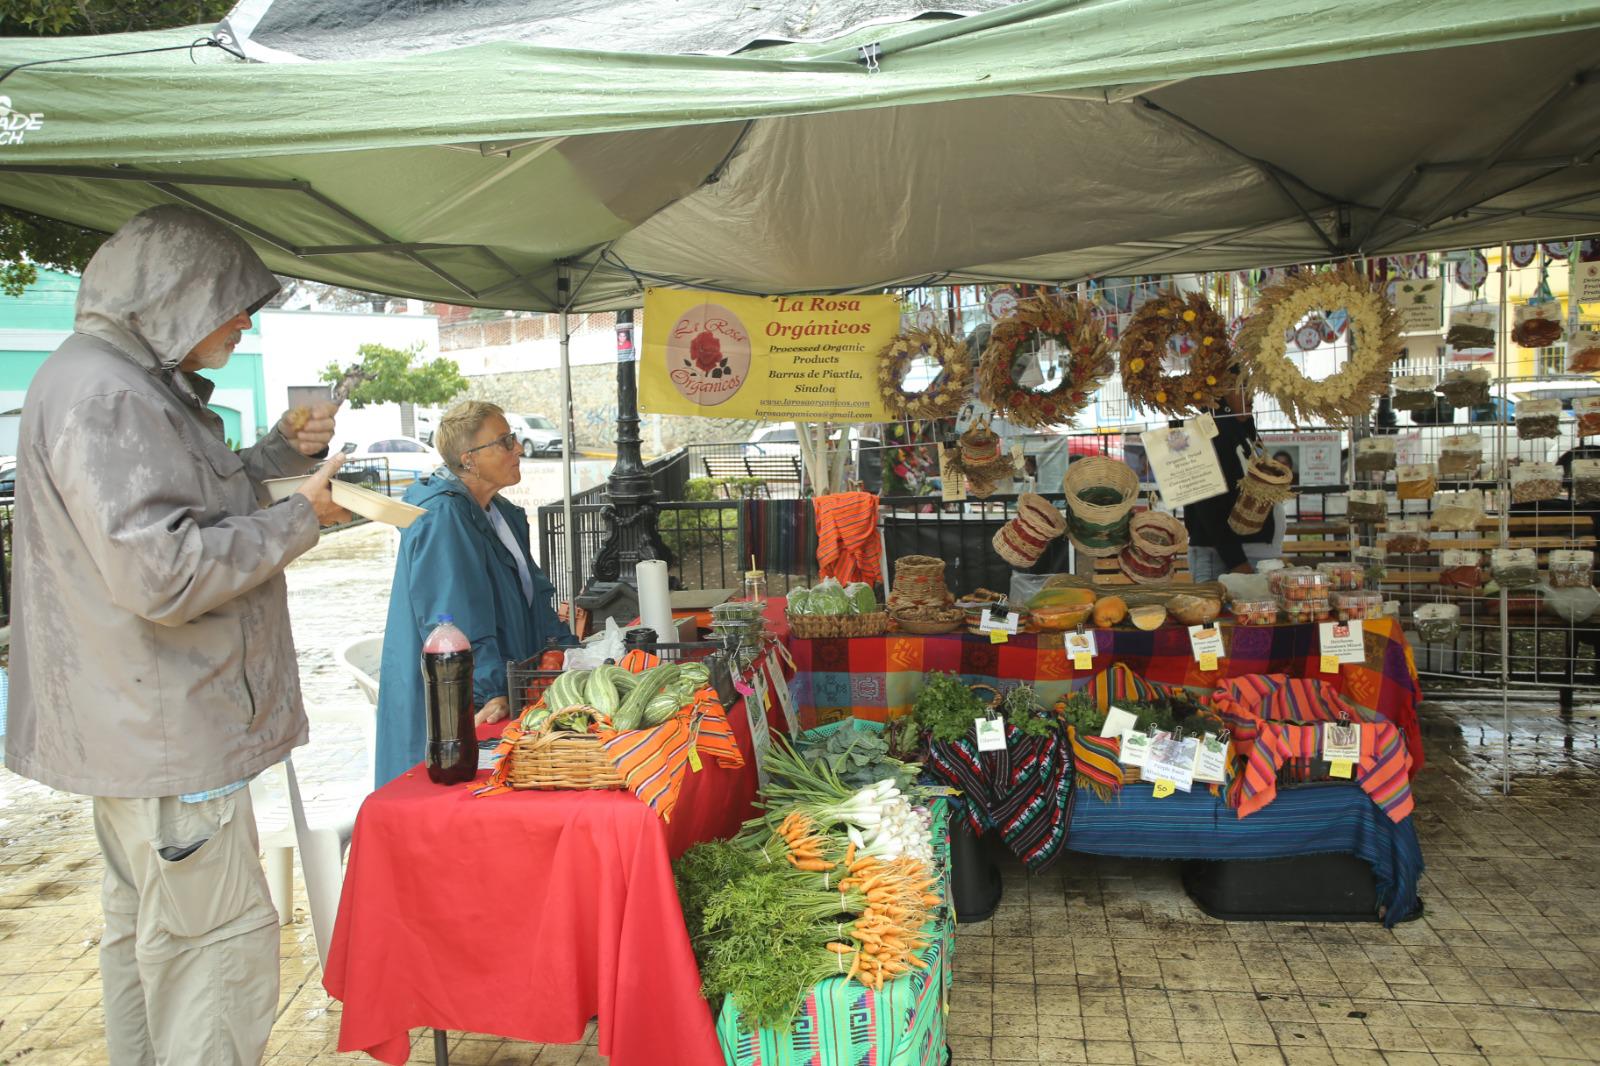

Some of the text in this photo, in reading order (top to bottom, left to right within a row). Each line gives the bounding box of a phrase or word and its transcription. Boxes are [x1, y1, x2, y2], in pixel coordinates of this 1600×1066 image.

[778, 297, 860, 312] La Rosa
[765, 320, 871, 340] Orgánicos
[769, 342, 866, 353] Processed Organic
[793, 354, 840, 364] Products
[768, 369, 806, 379] Barras
[807, 369, 820, 379] de
[794, 384, 836, 394] Sinaloa
[1157, 784, 1168, 792] 50
